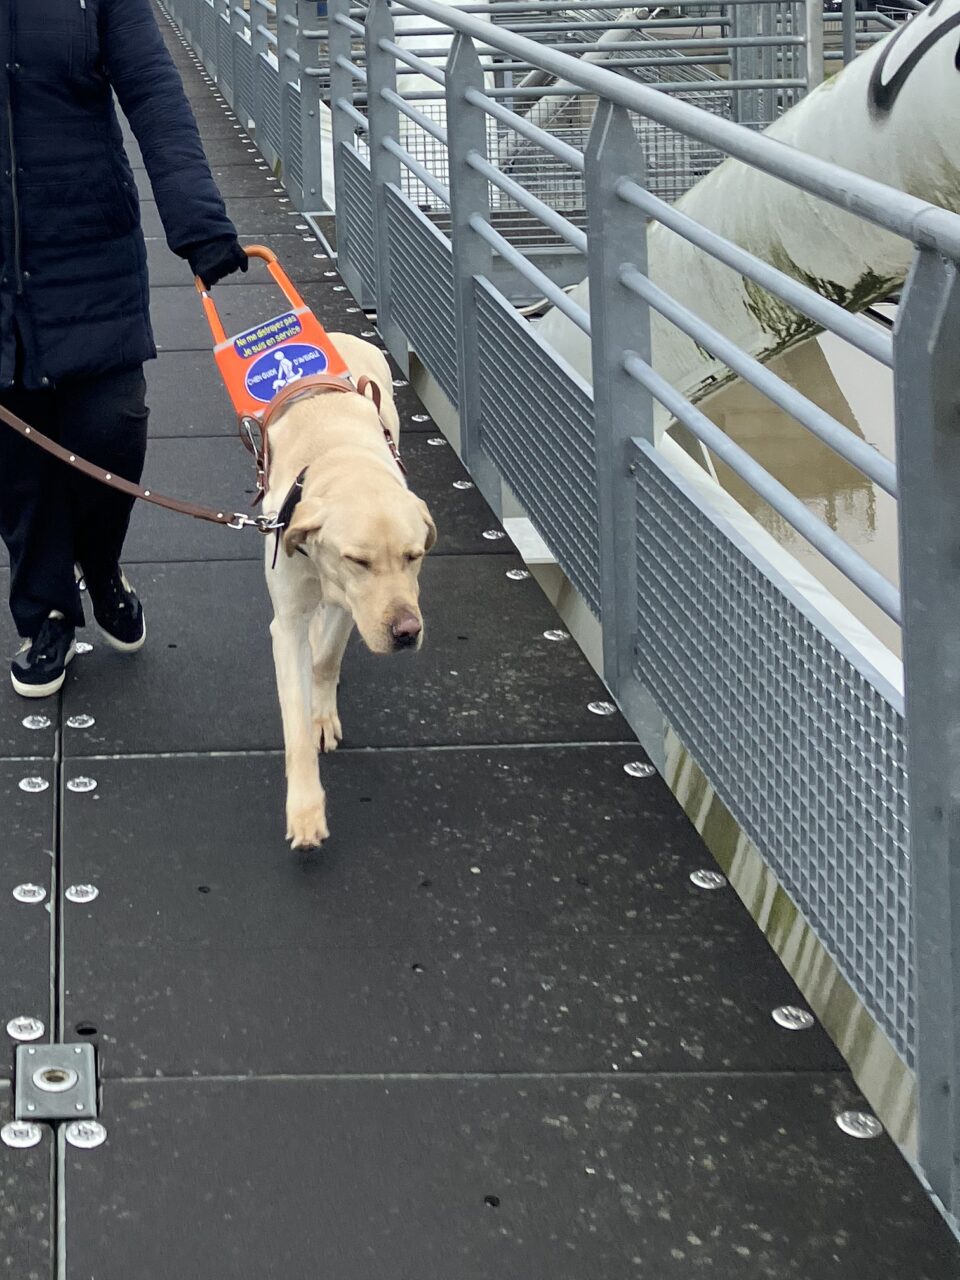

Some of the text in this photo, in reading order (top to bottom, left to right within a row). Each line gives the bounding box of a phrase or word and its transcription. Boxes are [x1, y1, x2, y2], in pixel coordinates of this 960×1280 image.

[284, 315, 297, 326] pas
[243, 325, 301, 357] Je suis en service
